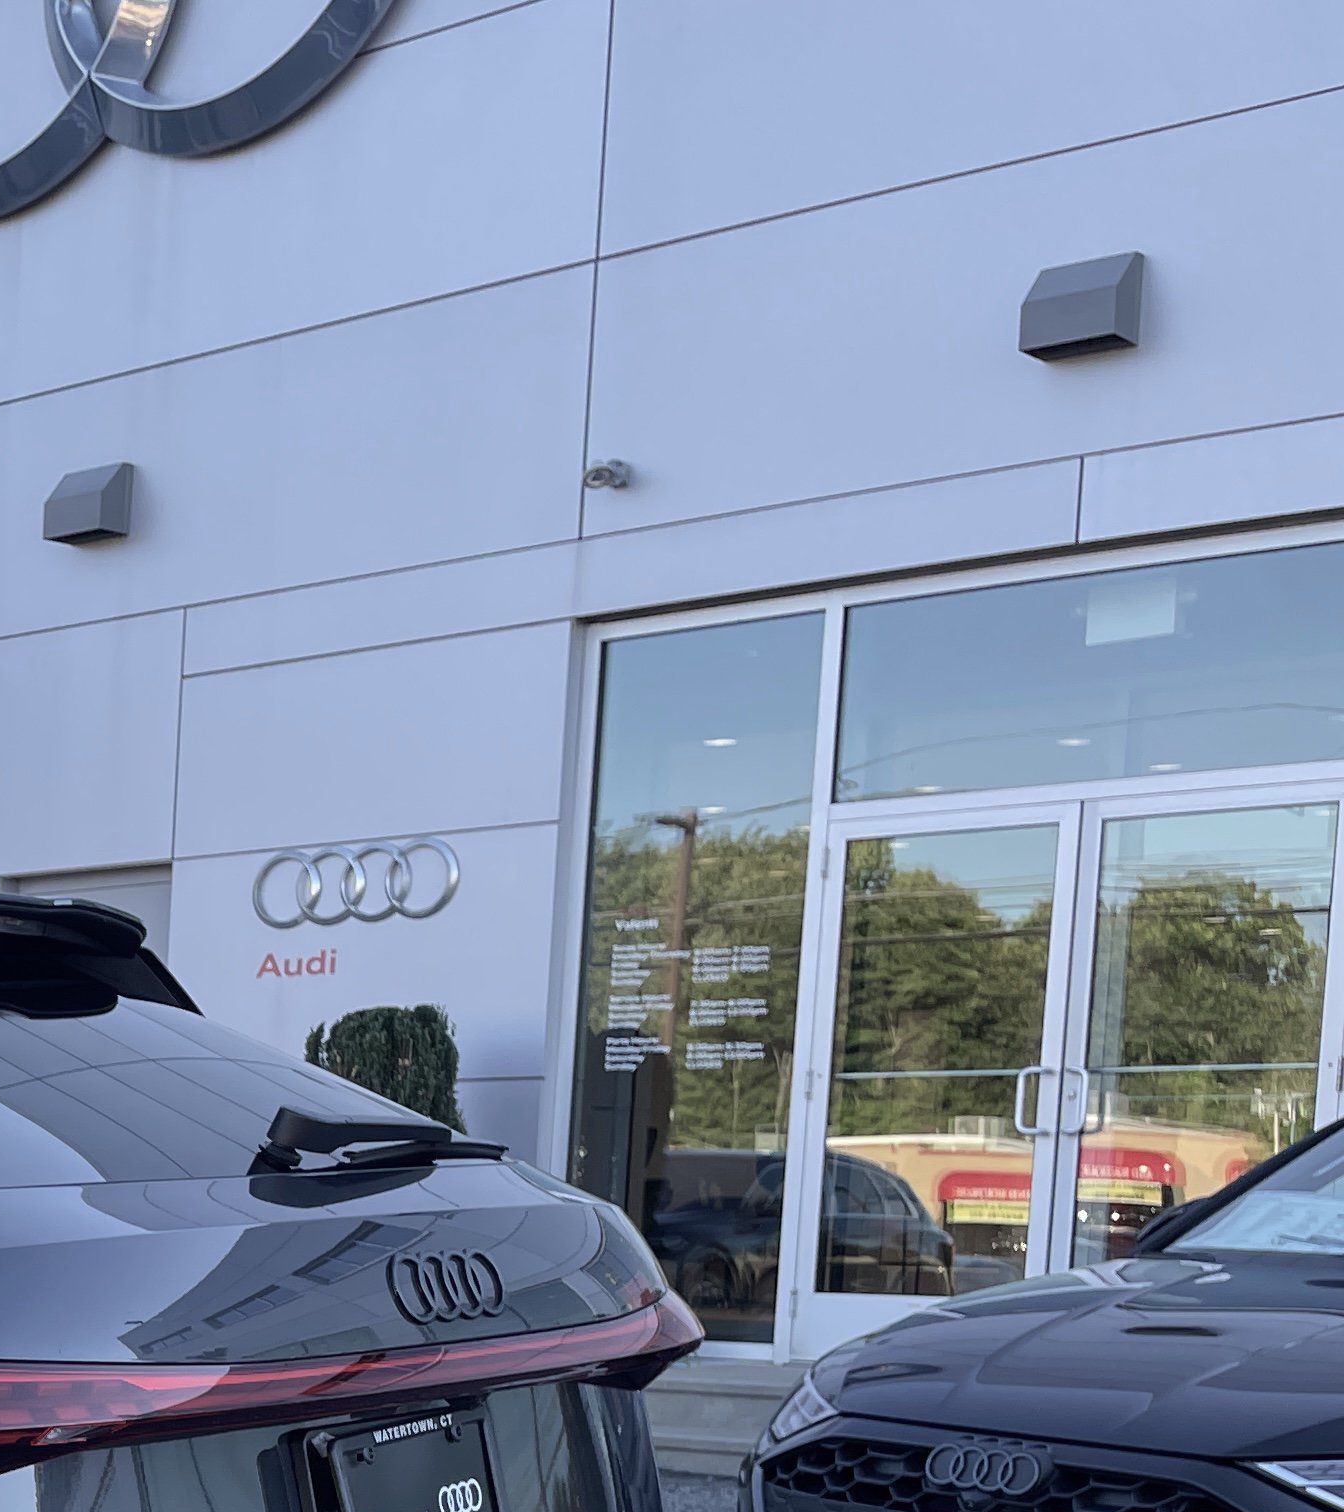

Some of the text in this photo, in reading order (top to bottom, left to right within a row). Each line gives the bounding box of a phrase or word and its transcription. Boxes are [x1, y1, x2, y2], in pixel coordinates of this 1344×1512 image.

[255, 947, 338, 980] Audi
[373, 1413, 453, 1444] WATERTOWN, CT
